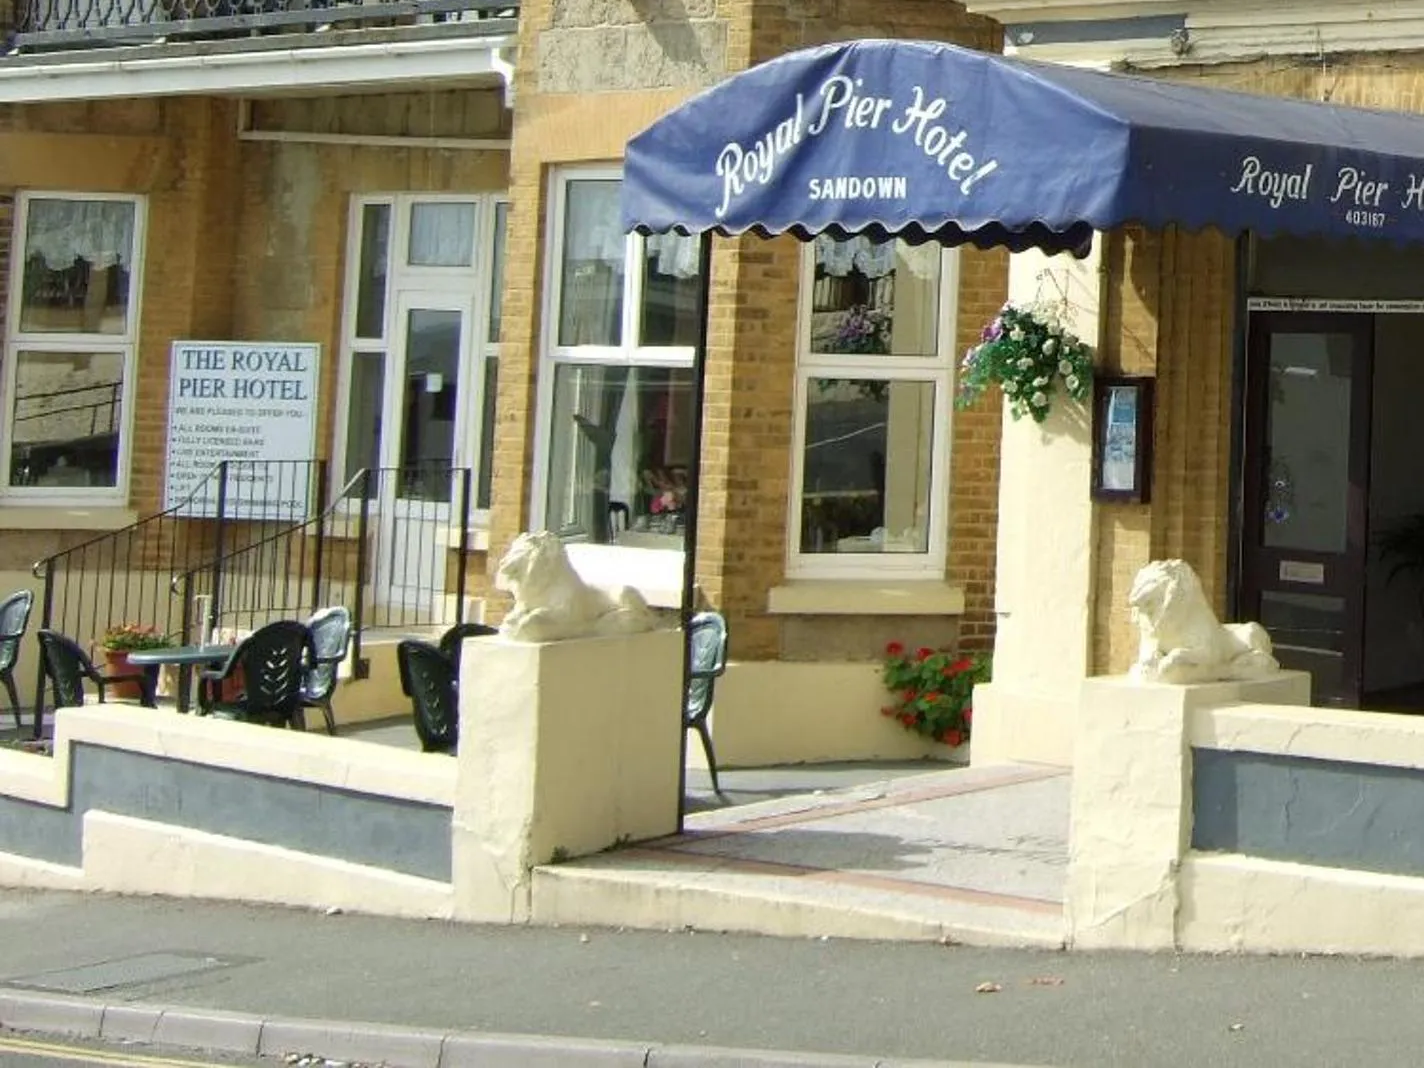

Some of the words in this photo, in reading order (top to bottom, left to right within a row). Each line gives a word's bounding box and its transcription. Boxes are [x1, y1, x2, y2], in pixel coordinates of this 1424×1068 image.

[714, 93, 803, 217] Royal
[808, 75, 893, 135] Pier
[892, 85, 998, 197] Hotel
[808, 176, 907, 201] SANDOWN
[1230, 155, 1314, 209] Royal
[1329, 167, 1389, 207] Pier
[182, 349, 225, 371] THE
[231, 351, 307, 373] ROYAL
[179, 378, 227, 399] PIER
[233, 380, 308, 401] HOTEL
